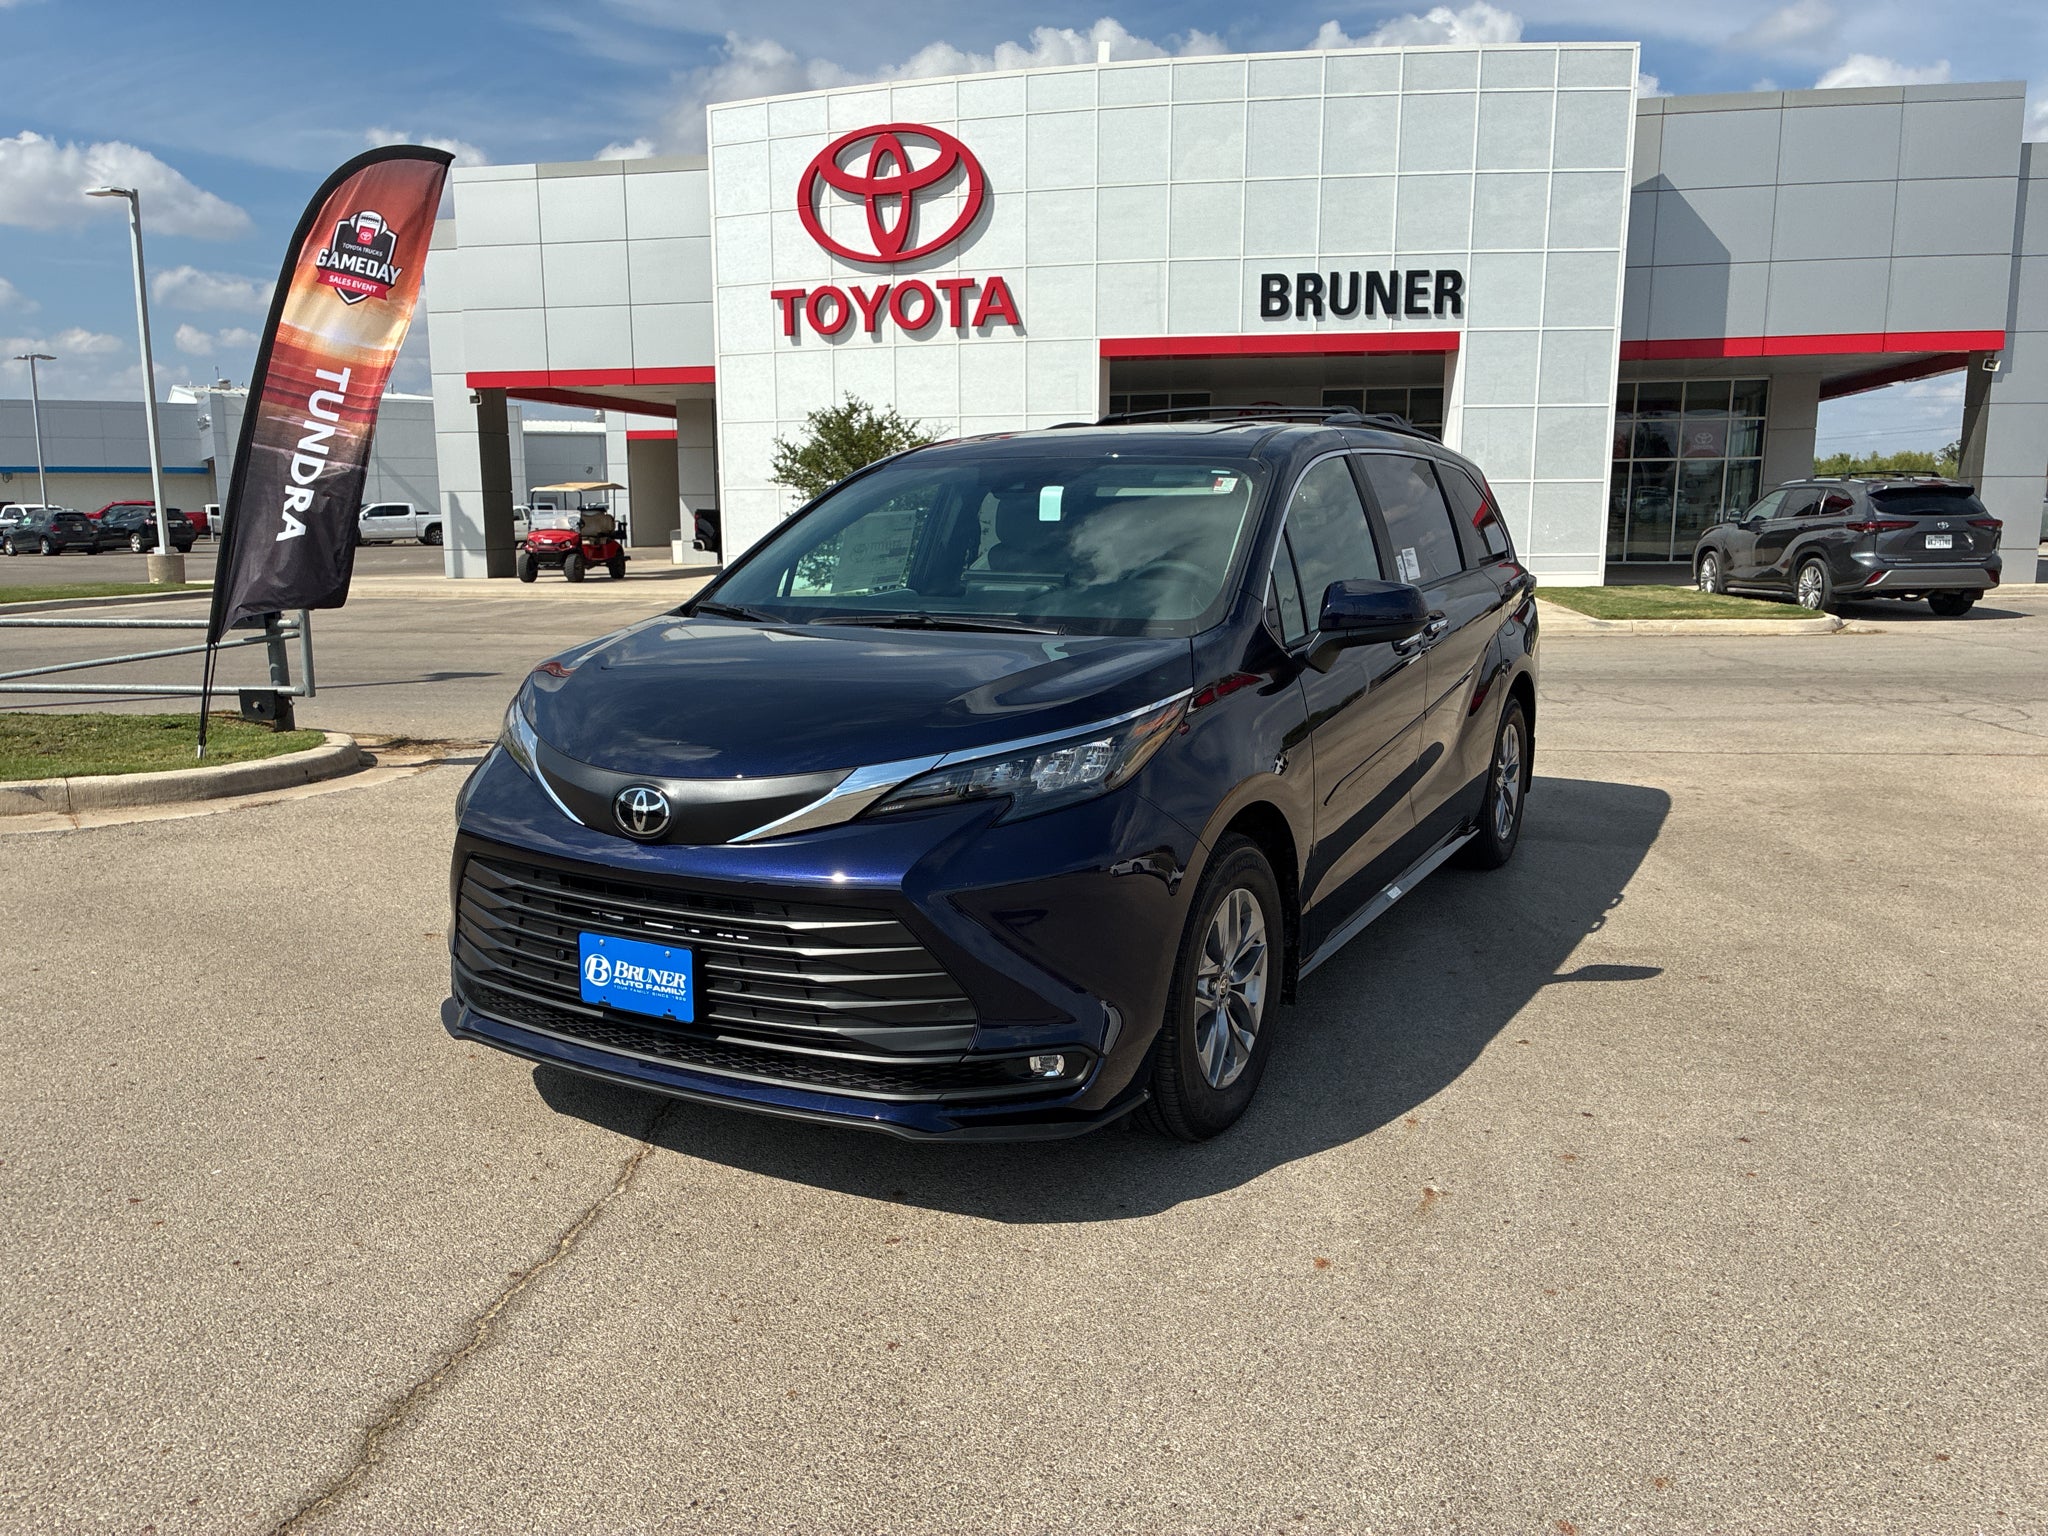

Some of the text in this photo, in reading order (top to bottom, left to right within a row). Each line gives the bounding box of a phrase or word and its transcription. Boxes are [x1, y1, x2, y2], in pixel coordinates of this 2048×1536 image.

[342, 242, 383, 257] TOYOTA TRUCKS
[315, 248, 402, 285] GAMEDAY
[328, 275, 378, 293] SALES EVENT
[1260, 270, 1463, 317] BRUNER
[771, 276, 1019, 336] TOYOTA
[276, 367, 351, 542] TUNDRA
[585, 957, 608, 981] B
[613, 960, 687, 988] BRUNER
[613, 978, 687, 996] AUTO FAMILY
